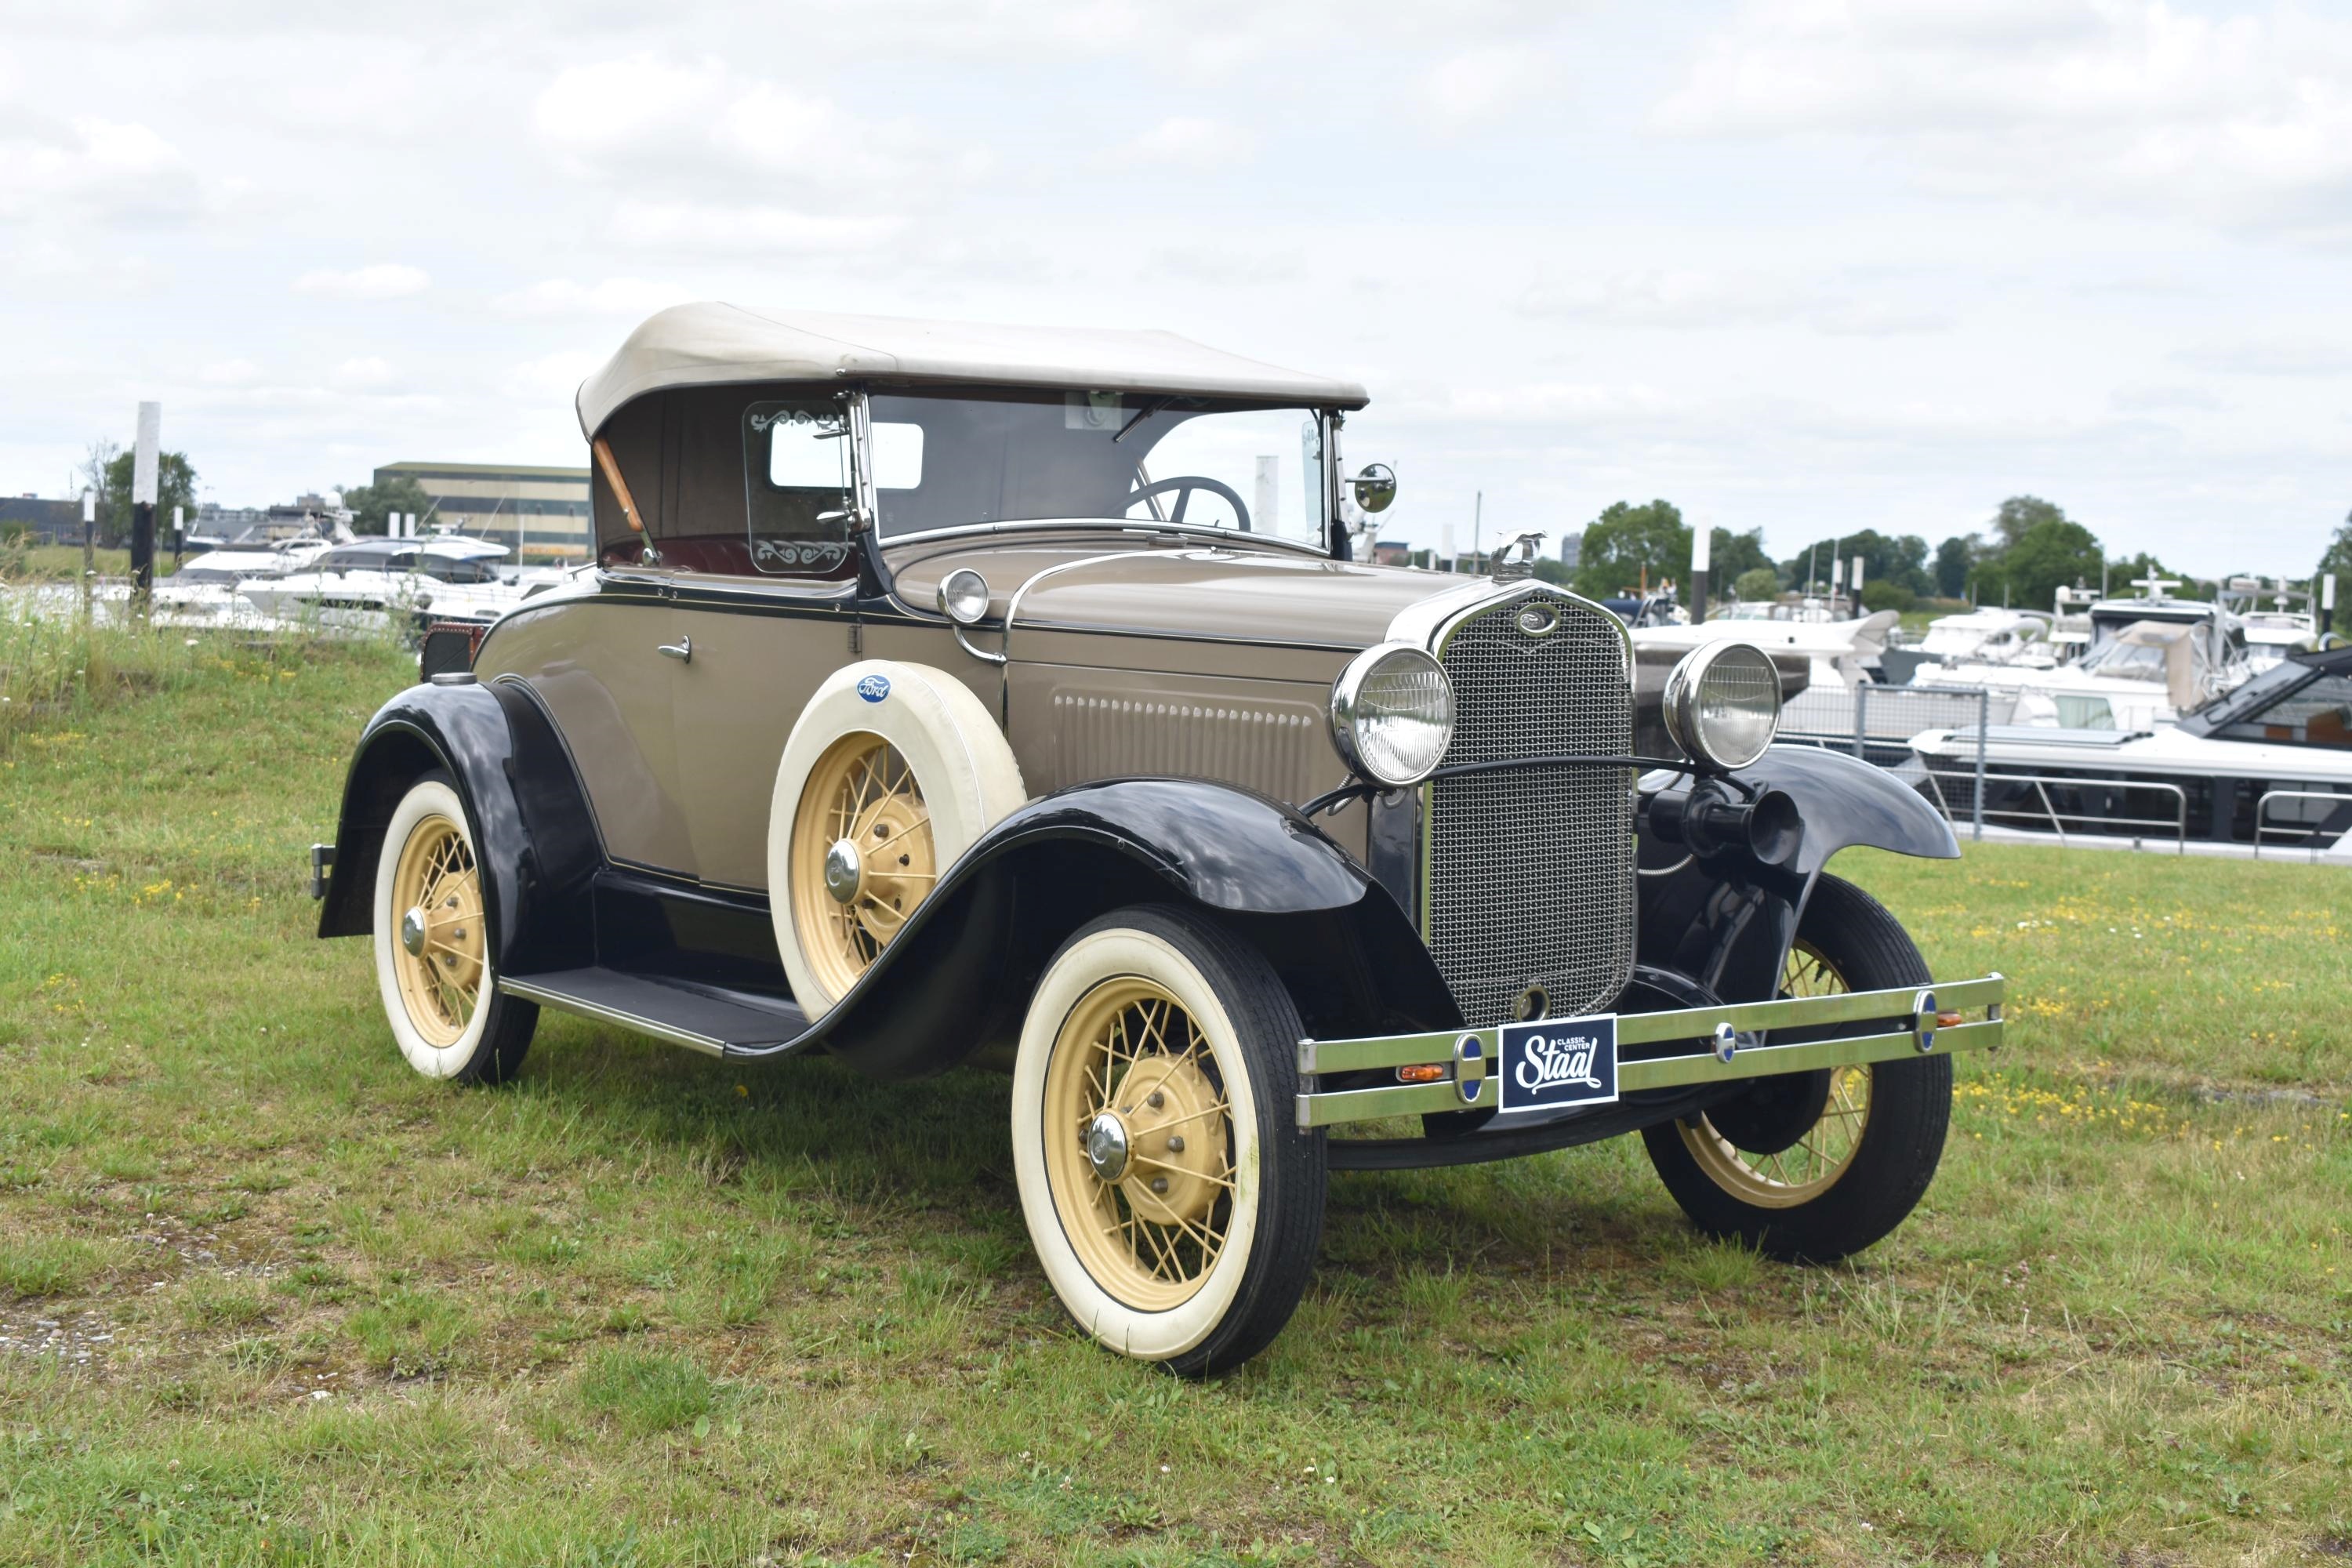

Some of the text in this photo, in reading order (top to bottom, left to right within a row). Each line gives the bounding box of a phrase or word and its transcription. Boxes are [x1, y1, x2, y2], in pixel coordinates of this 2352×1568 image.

[859, 677, 888, 697] Ford
[1557, 1036, 1585, 1045] CLASSIC
[1564, 1043, 1590, 1051] CENTER
[1515, 1035, 1602, 1094] Staal
